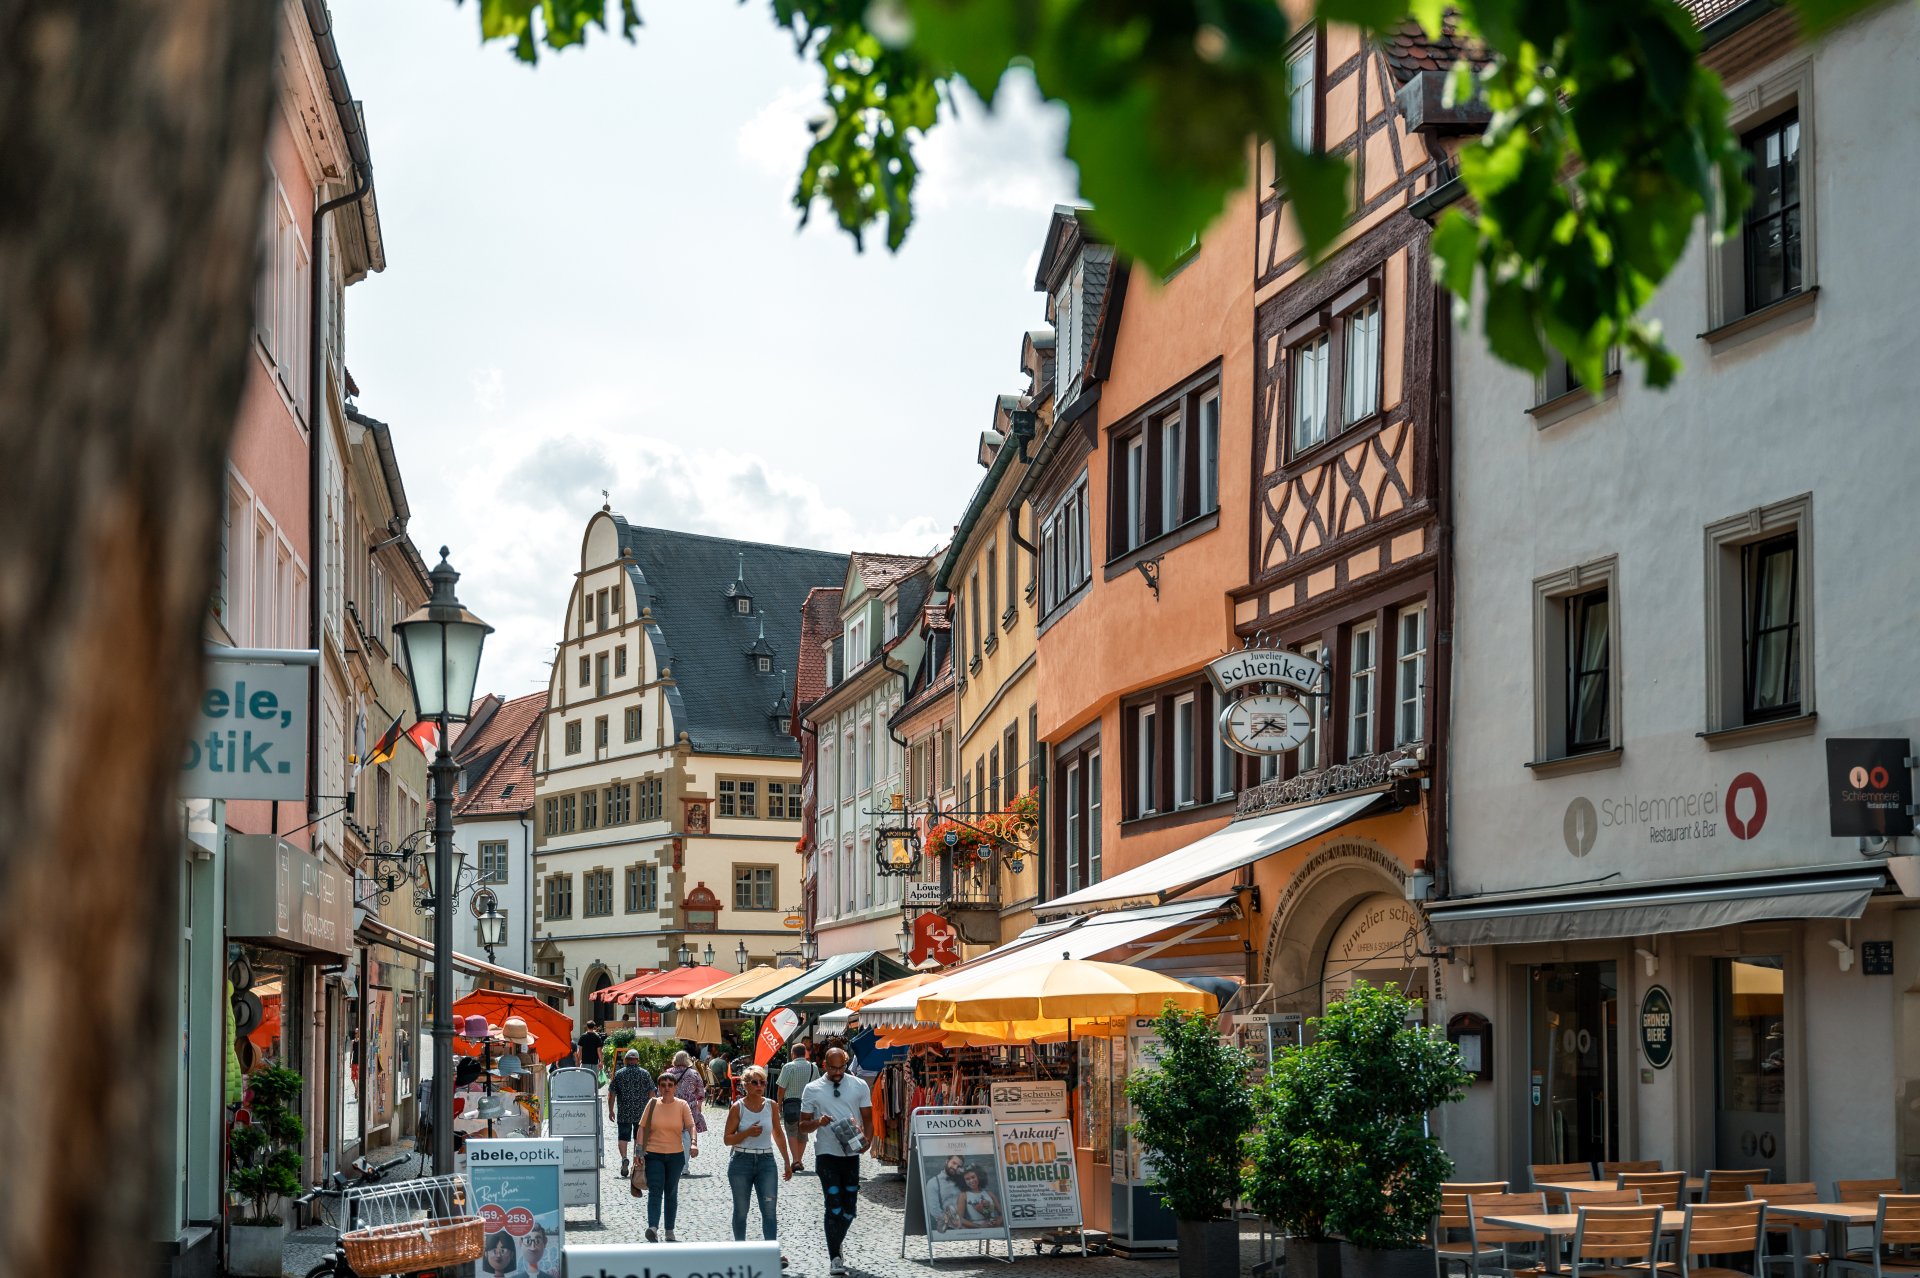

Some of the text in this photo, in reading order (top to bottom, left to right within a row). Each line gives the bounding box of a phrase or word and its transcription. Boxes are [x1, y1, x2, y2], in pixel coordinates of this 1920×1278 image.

[1250, 652, 1282, 660] Juwelier
[1221, 659, 1315, 685] schenkel
[201, 680, 292, 729] ele,
[1841, 790, 1900, 802] Schlemmerei
[1601, 783, 1718, 828] Schlemmerei
[1650, 819, 1718, 844] Restaurant & Bar
[916, 883, 940, 891] Löwe
[910, 890, 941, 901] Apothe
[1341, 906, 1386, 962] juwelier
[763, 1027, 780, 1051] VDSL
[1647, 1028, 1666, 1042] BIERE
[1022, 1090, 1064, 1098] schenkel
[926, 1118, 982, 1129] PANDORA
[1003, 1141, 1057, 1165] GOLD
[1006, 1163, 1071, 1182] BARGELD
[507, 1213, 533, 1224] 259,-
